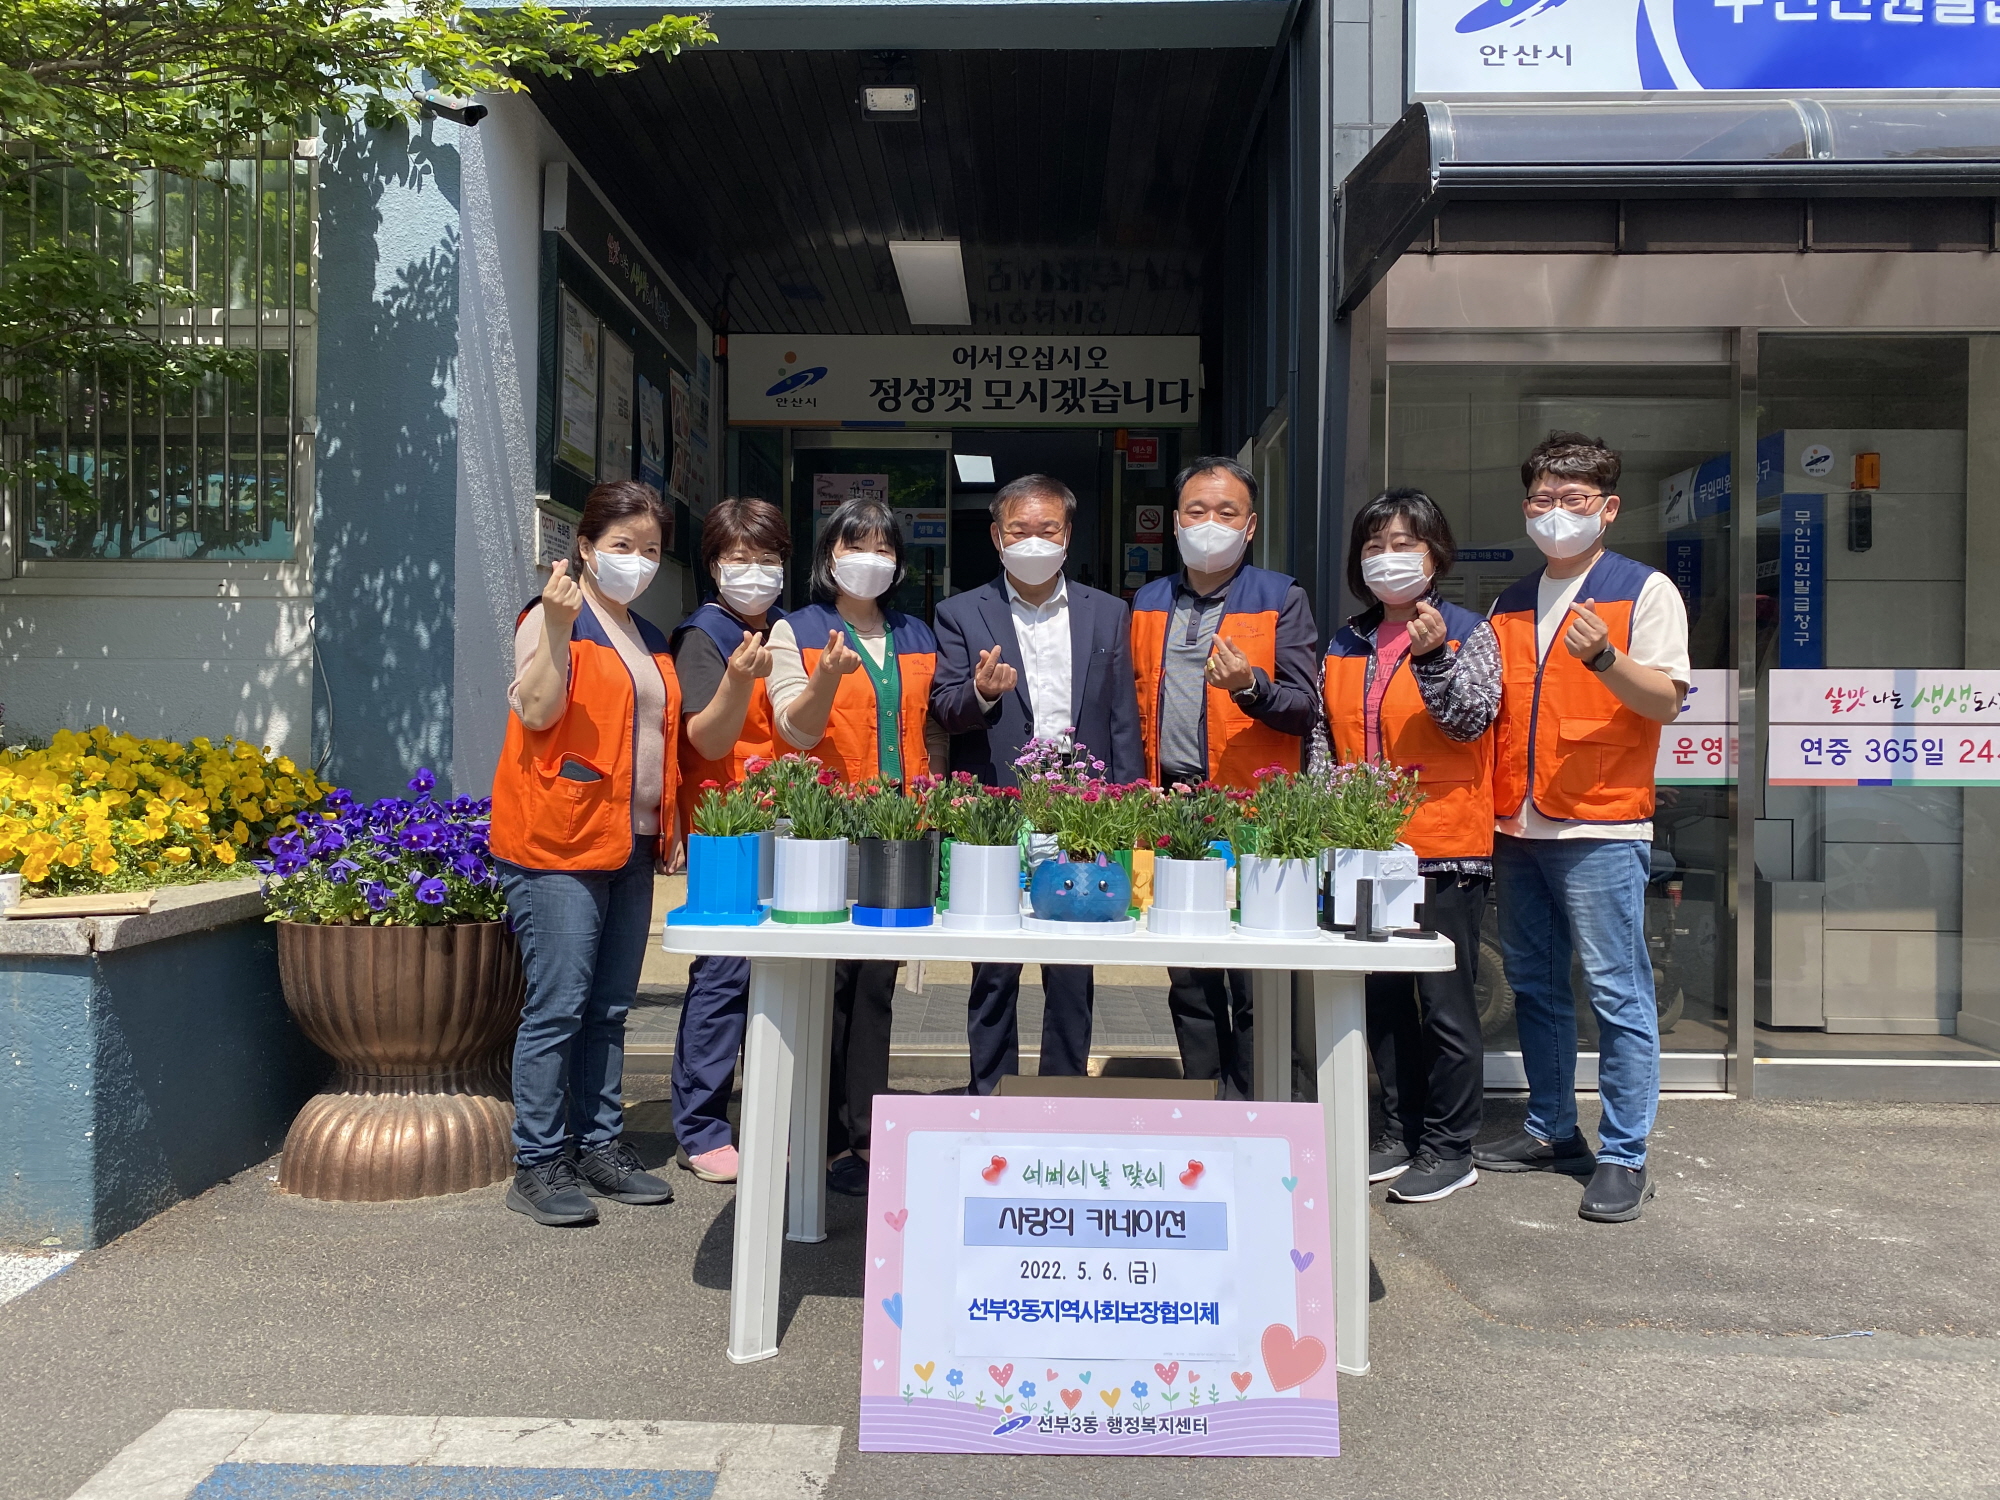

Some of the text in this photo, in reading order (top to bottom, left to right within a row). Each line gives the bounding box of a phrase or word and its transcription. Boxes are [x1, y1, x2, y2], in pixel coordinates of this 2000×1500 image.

[1479, 44, 1573, 68] 안산시
[953, 345, 1109, 372] 어서오십시오
[775, 396, 818, 408] 안산시
[869, 377, 1195, 415] 정성껏 모시겠습니다
[1793, 510, 1811, 647] 무인민원발급창구
[1824, 685, 1868, 714] 살맛
[1799, 738, 2000, 766] 연중 365일 24
[1022, 1159, 1111, 1189] 어버이날
[998, 1206, 1187, 1239] 사랑의 카네이션
[1019, 1261, 1158, 1285] 2022. 5. 6. (금)
[967, 1297, 1221, 1327] 선부3동지역사회보장협의체
[1036, 1414, 1210, 1436] 선부3동 행정복지센터
